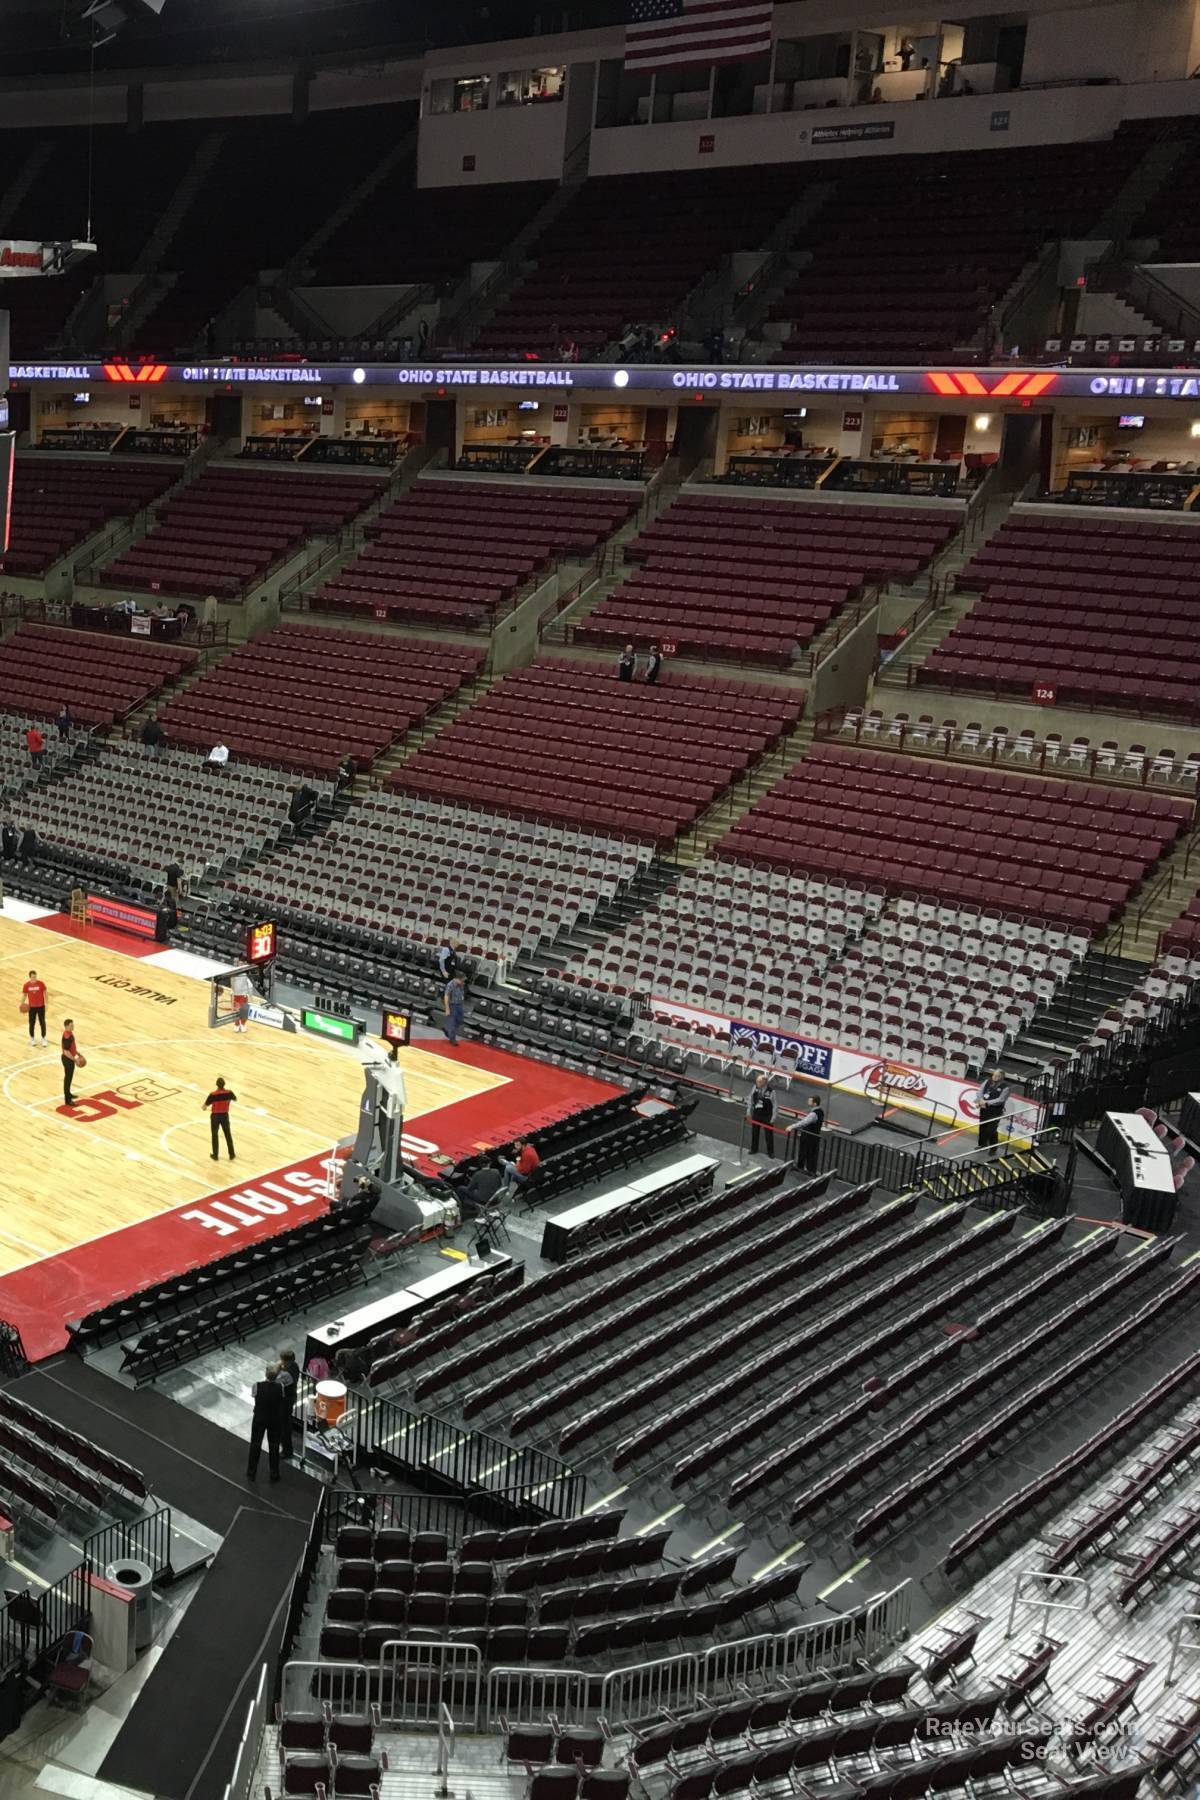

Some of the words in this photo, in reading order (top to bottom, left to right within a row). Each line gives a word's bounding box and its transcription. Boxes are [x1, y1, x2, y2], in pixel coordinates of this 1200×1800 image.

[8, 366, 90, 379] BASKETBALL
[248, 369, 322, 381] BASKETBALL
[399, 370, 433, 383] OHIO
[436, 371, 477, 384] STATE
[480, 371, 574, 385] BASKETBALL
[673, 373, 717, 387] OHIO
[720, 373, 774, 388] STATE
[778, 374, 899, 390] BASKETBALL
[845, 416, 860, 425] 223
[663, 644, 676, 653] 123
[1037, 689, 1053, 699] 124
[251, 938, 272, 960] 30
[88, 973, 129, 990] CITY
[127, 984, 179, 1006] VALUE
[180, 1170, 341, 1237] STATE
